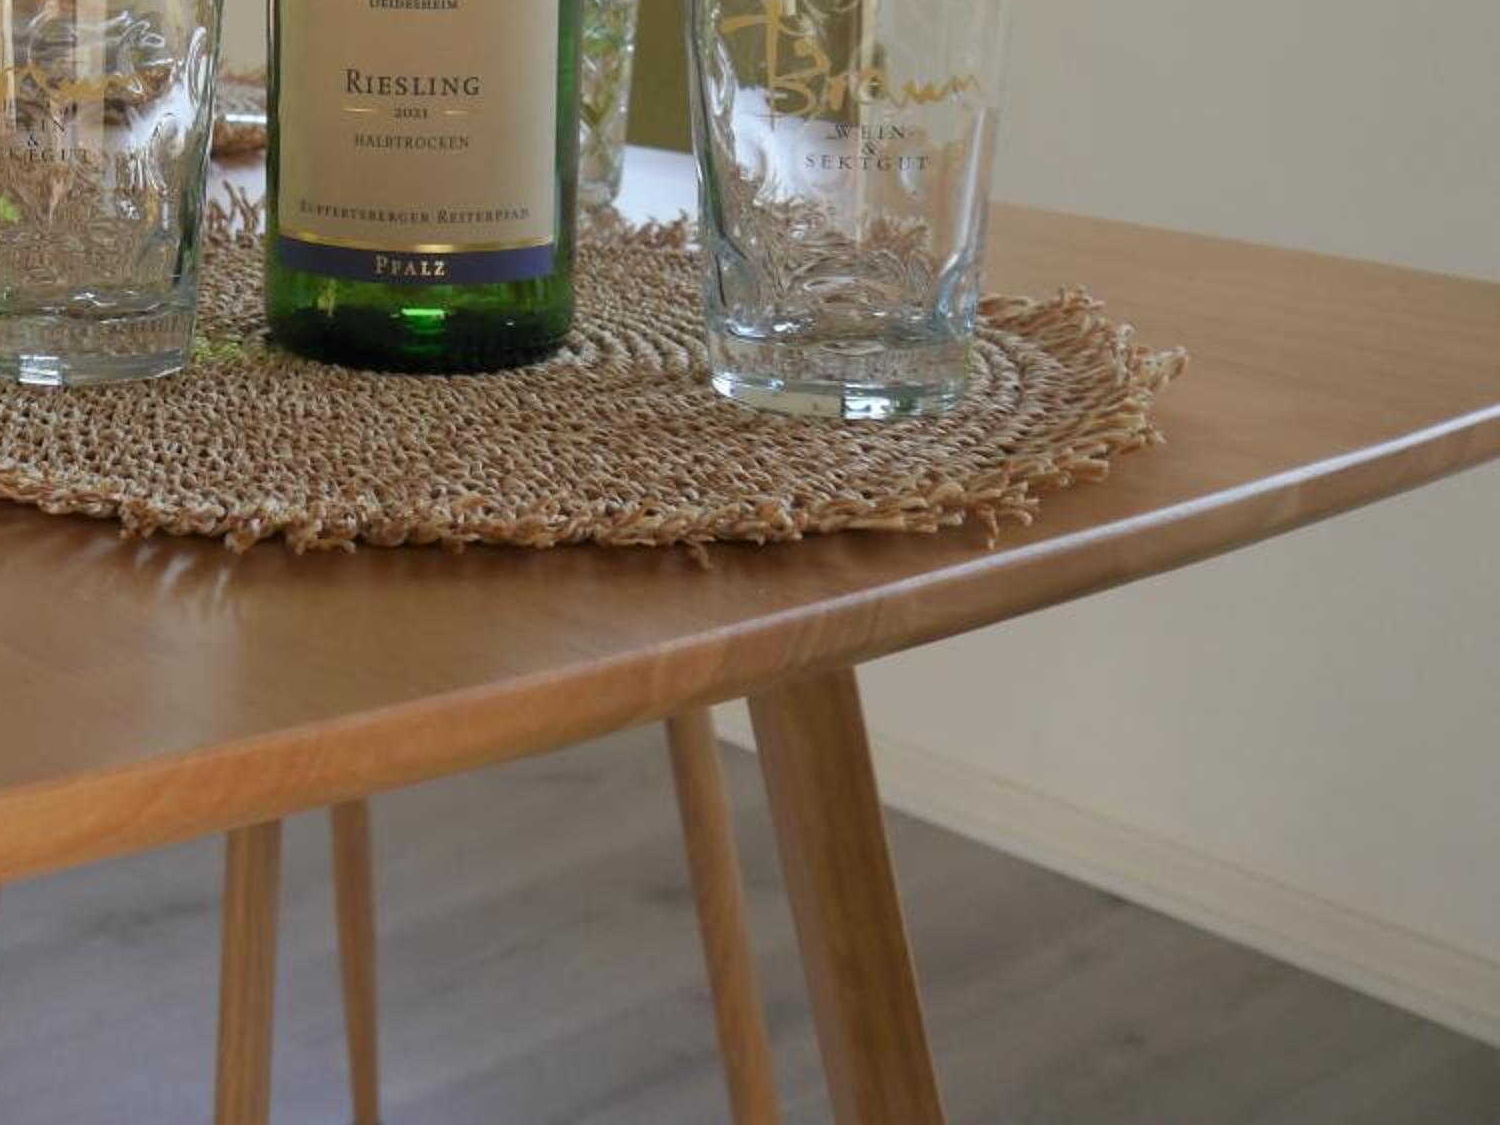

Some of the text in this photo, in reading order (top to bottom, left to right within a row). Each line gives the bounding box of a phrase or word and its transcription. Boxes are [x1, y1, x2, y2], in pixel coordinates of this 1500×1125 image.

[346, 68, 481, 96] RIESLING
[835, 123, 906, 140] WEIN
[804, 154, 930, 172] SEKTGUT
[374, 254, 446, 277] PFALZ
